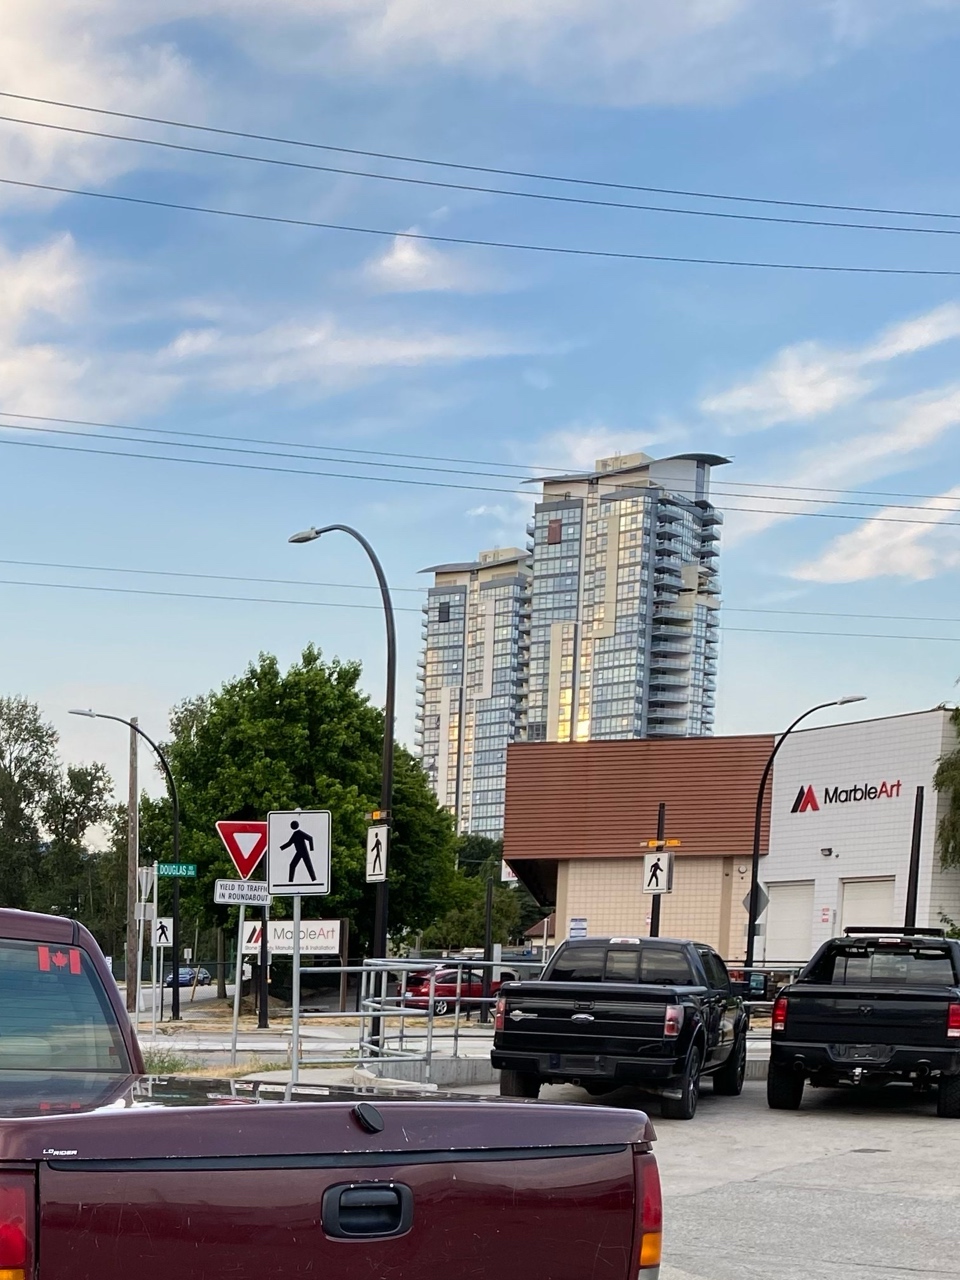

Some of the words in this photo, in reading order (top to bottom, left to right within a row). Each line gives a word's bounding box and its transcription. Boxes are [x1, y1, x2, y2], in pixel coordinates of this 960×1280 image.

[824, 780, 902, 804] MarbleArt
[160, 864, 187, 875] DOUGLAS
[220, 883, 236, 891] YIELD
[238, 884, 245, 892] TO
[228, 893, 269, 902] ROUNDABOUT
